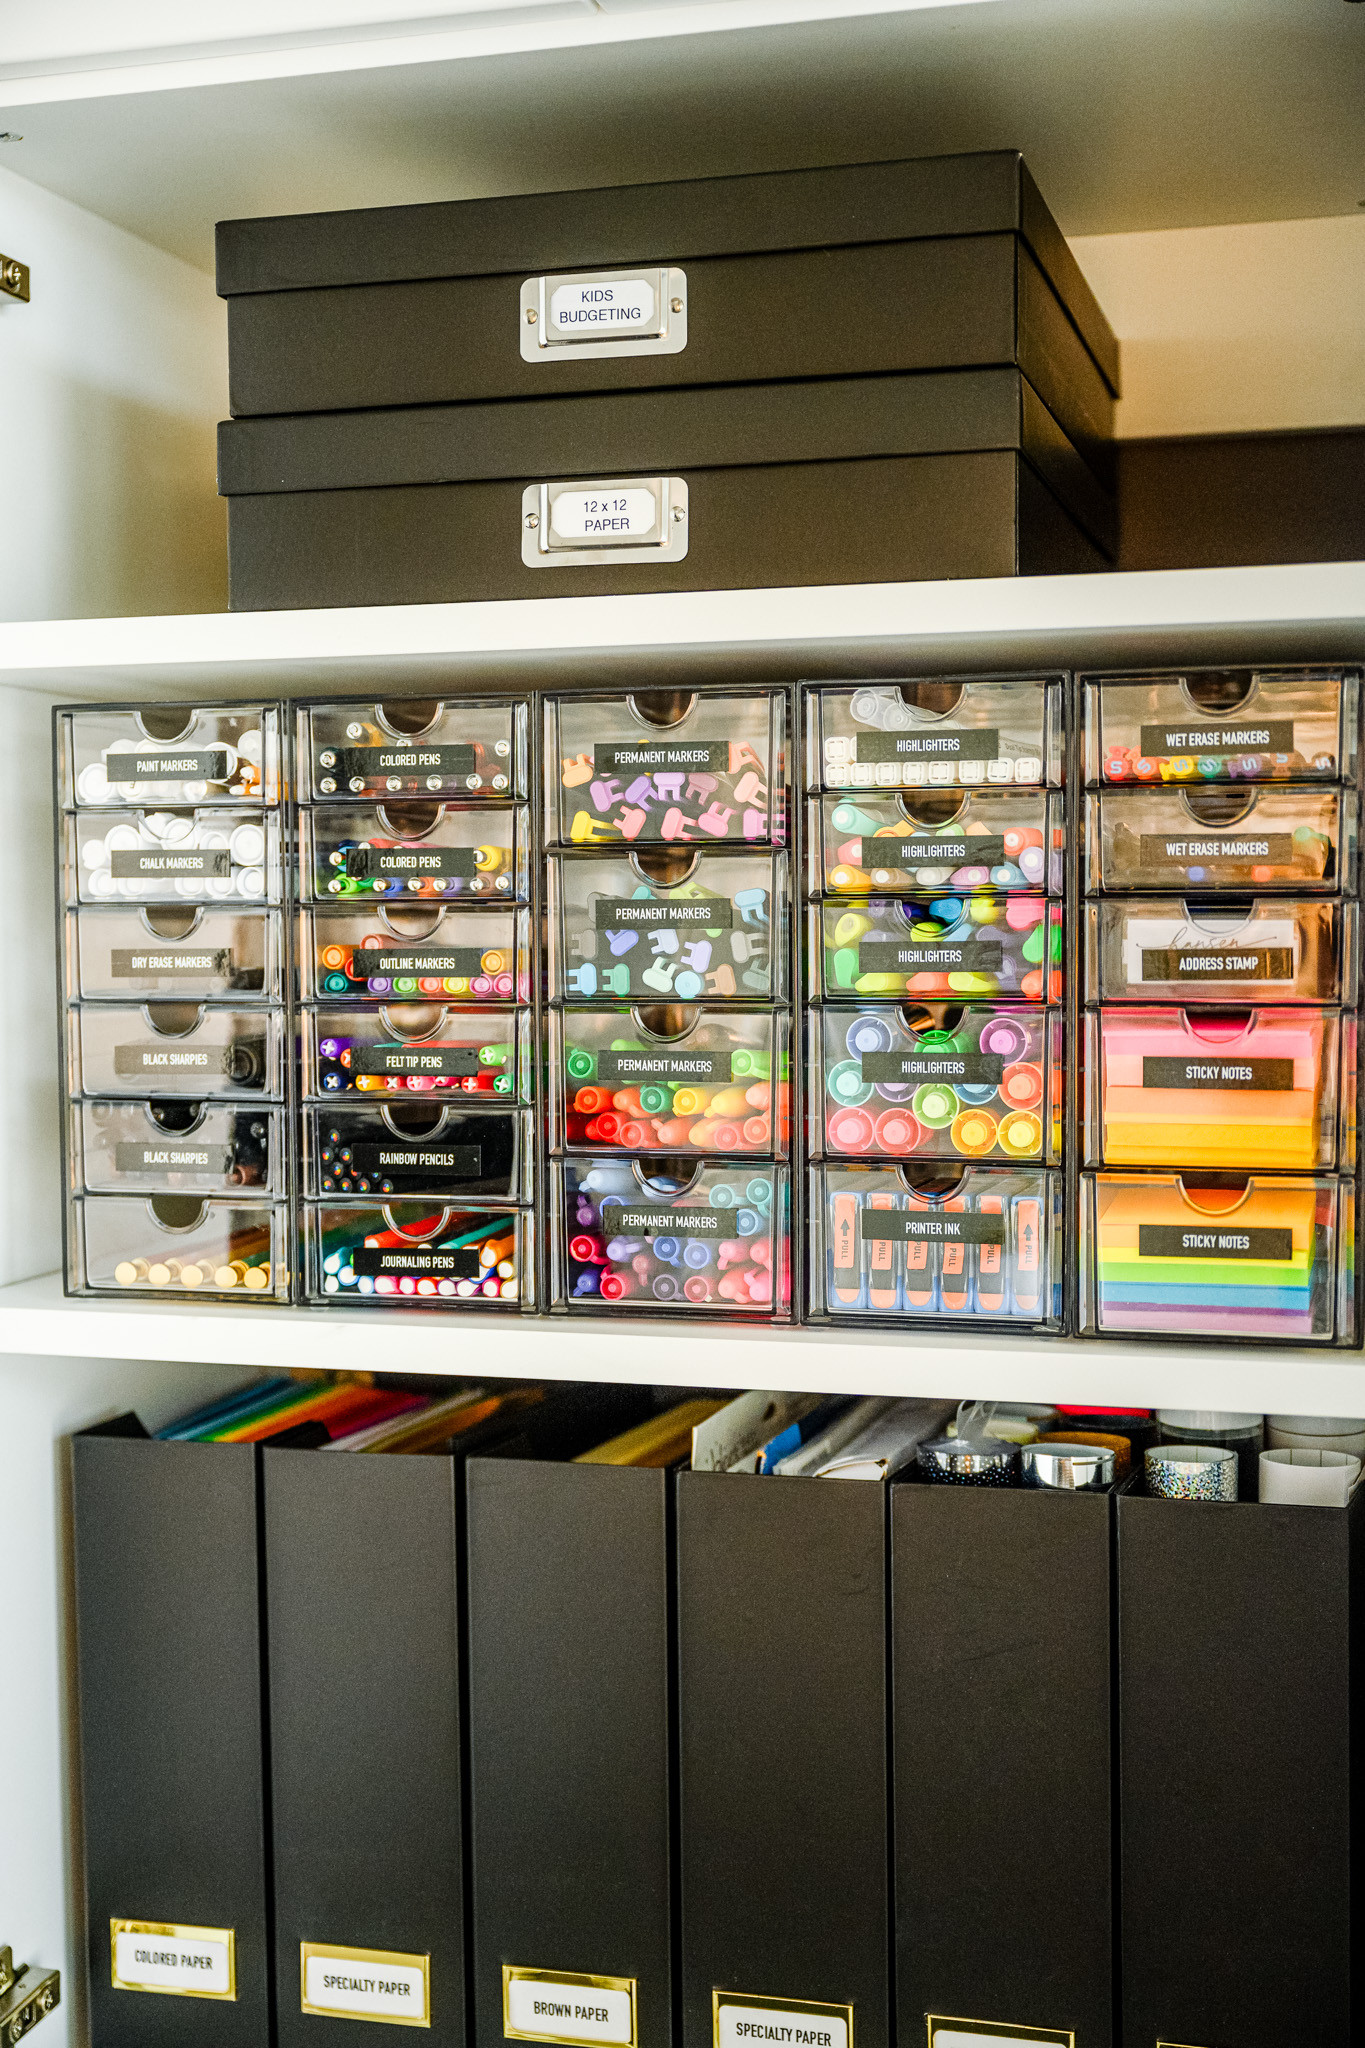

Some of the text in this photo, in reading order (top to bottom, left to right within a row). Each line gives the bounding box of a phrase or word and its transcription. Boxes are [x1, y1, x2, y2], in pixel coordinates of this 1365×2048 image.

[582, 289, 613, 303] KIDS
[560, 307, 640, 324] BUDGETING
[584, 500, 597, 513] 12
[613, 498, 626, 511] 12
[586, 517, 629, 532] PAPER
[897, 738, 959, 752] HIGHLIGHTERS
[1166, 730, 1269, 747] WET ERASE MARKERS
[380, 753, 440, 767] COLORED PENS
[615, 749, 709, 764] PERMANENT MARKERS
[137, 758, 198, 773] PAINT MARKERS
[902, 844, 965, 858] HIGHLIGHTERS
[1166, 841, 1268, 856] WET ERASE MARKERS
[140, 856, 203, 870] CHALK MARKERS
[381, 856, 441, 869] COLORED PENS
[616, 907, 710, 920] PERMANENT MARKERS
[132, 956, 212, 969] DRY ERASE MARKERS
[380, 957, 455, 970] OUTLINE MARKERS
[899, 949, 961, 963] HIGHLIGHTERS
[1179, 956, 1258, 971] ADDRESS STAMP
[143, 1053, 207, 1066] BLACK SHARPIES
[387, 1055, 442, 1068] FELT TIP PENS
[618, 1059, 711, 1073] PERMANENT MARKERS
[902, 1061, 964, 1074] HIGHLIGHTERS
[1186, 1065, 1252, 1080] STICKY NOTES
[144, 1151, 208, 1165] BLACK SHARPIES
[380, 1152, 454, 1166] RAINBOW PENCILS
[623, 1214, 717, 1229] PERMANENT MARKERS
[906, 1221, 960, 1236] PRINTER INK
[841, 1239, 849, 1259] PULL
[1183, 1234, 1249, 1250] STICKY NOTES
[948, 1247, 957, 1266] PULL
[1025, 1244, 1033, 1264] PULL
[381, 1255, 454, 1269] JOURNALING PENS
[136, 1949, 212, 1970] COLORED PAPER
[324, 1975, 410, 1996] SPECIALTY PAPER
[534, 2001, 608, 2023] BROWN PAPER
[737, 2022, 831, 2047] SPECIALTY PAPER
